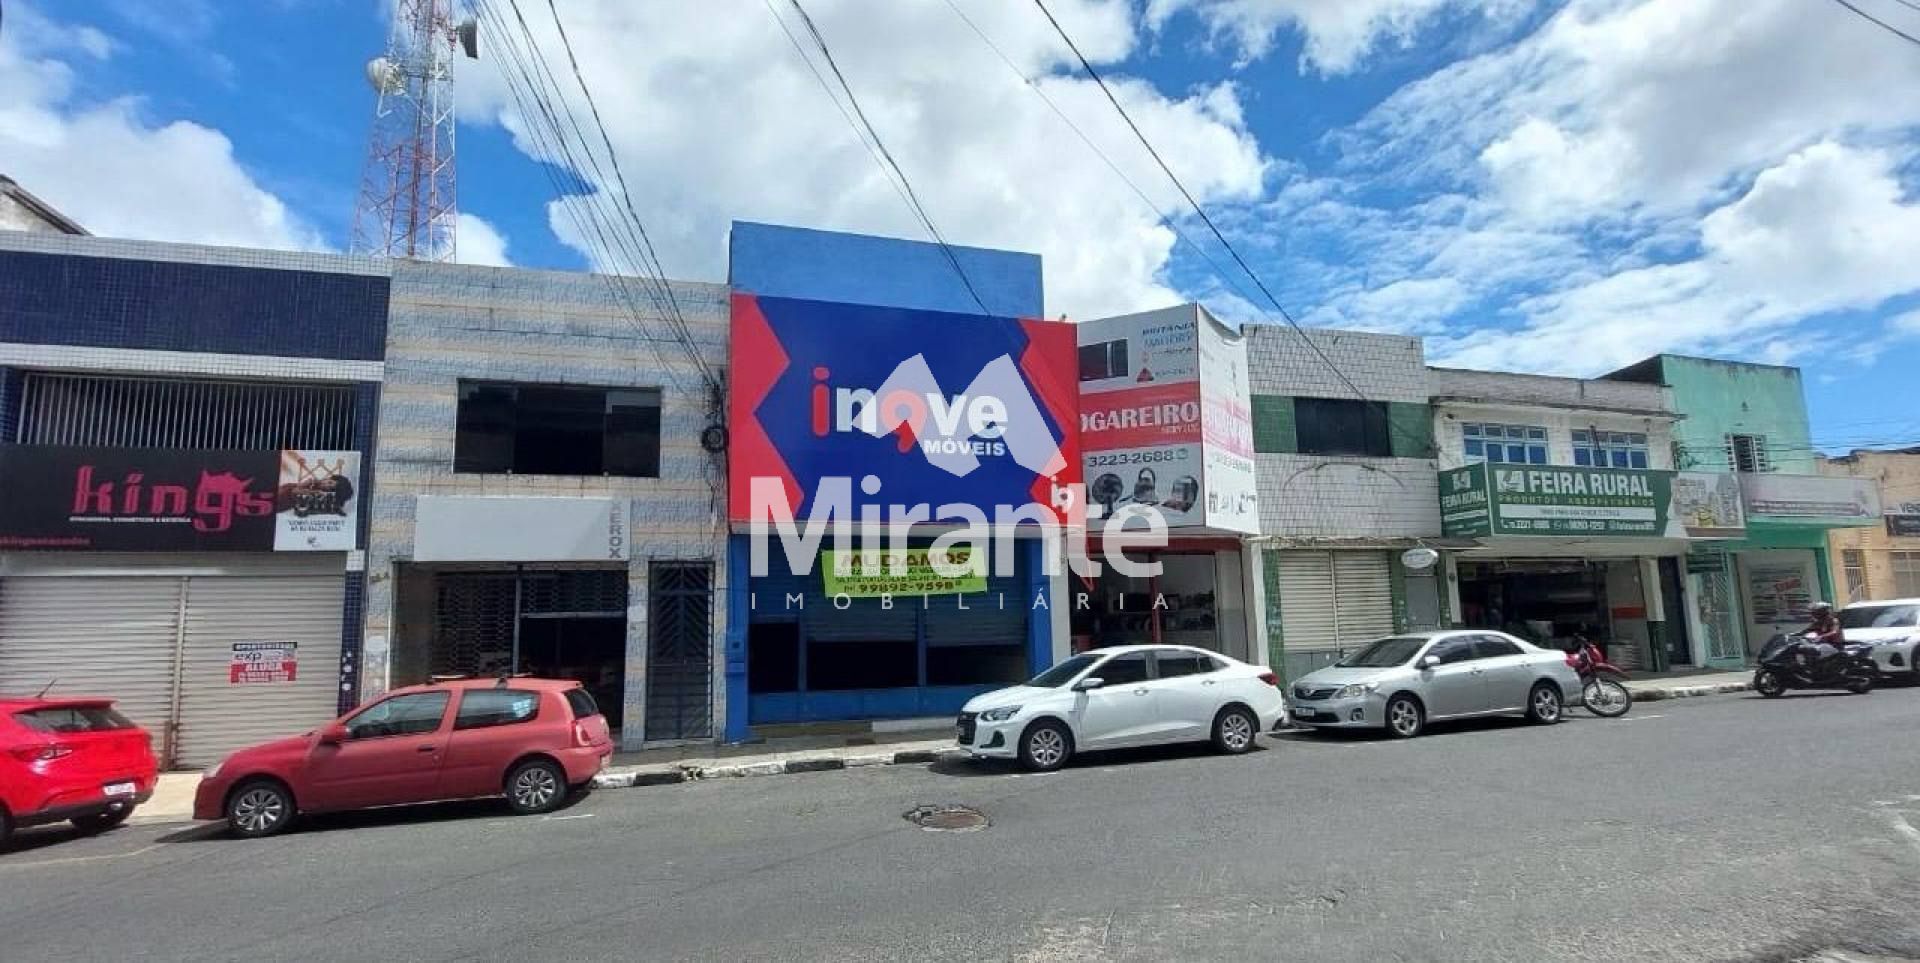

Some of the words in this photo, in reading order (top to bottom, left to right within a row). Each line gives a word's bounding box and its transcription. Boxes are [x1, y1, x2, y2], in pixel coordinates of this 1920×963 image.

[924, 437, 1007, 456] MÓVEIS
[1087, 450, 1172, 467] 3223-2688
[1528, 470, 1587, 495] FEIRA
[1590, 473, 1653, 496] RURAL
[71, 464, 274, 531] kings
[840, 551, 971, 568] MUDAMOS
